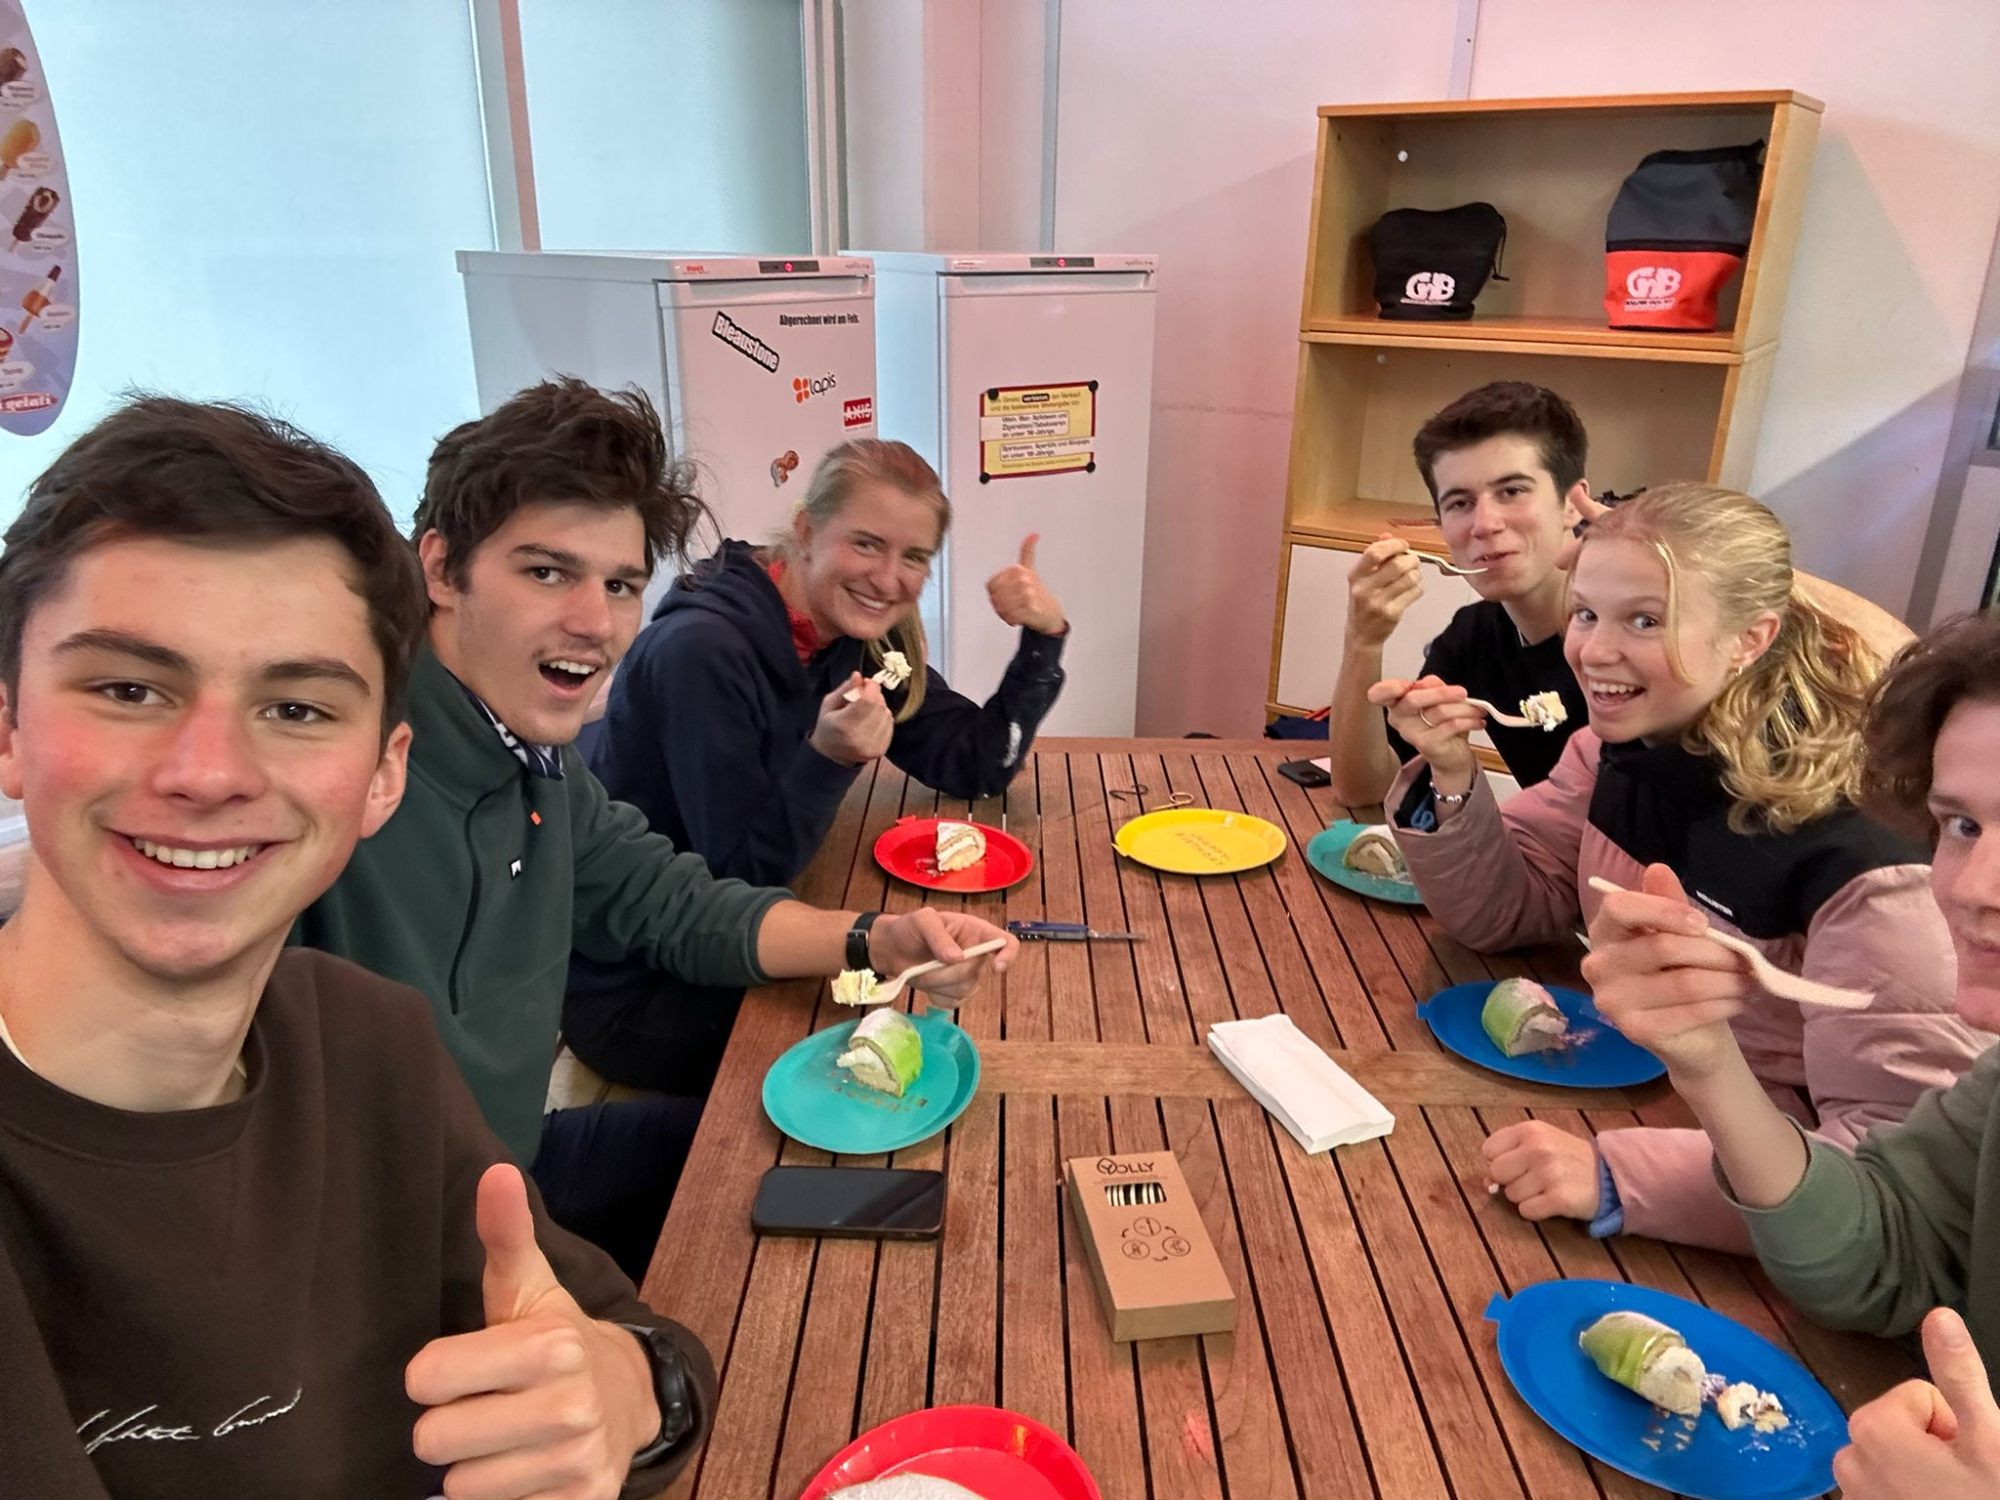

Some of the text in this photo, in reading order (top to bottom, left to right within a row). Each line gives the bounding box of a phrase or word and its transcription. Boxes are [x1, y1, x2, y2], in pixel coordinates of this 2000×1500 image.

[780, 314, 822, 327] Abgerechnet
[823, 314, 836, 324] wird
[838, 315, 846, 324] am
[714, 314, 778, 370] Bleaustone
[809, 372, 836, 396] lapis
